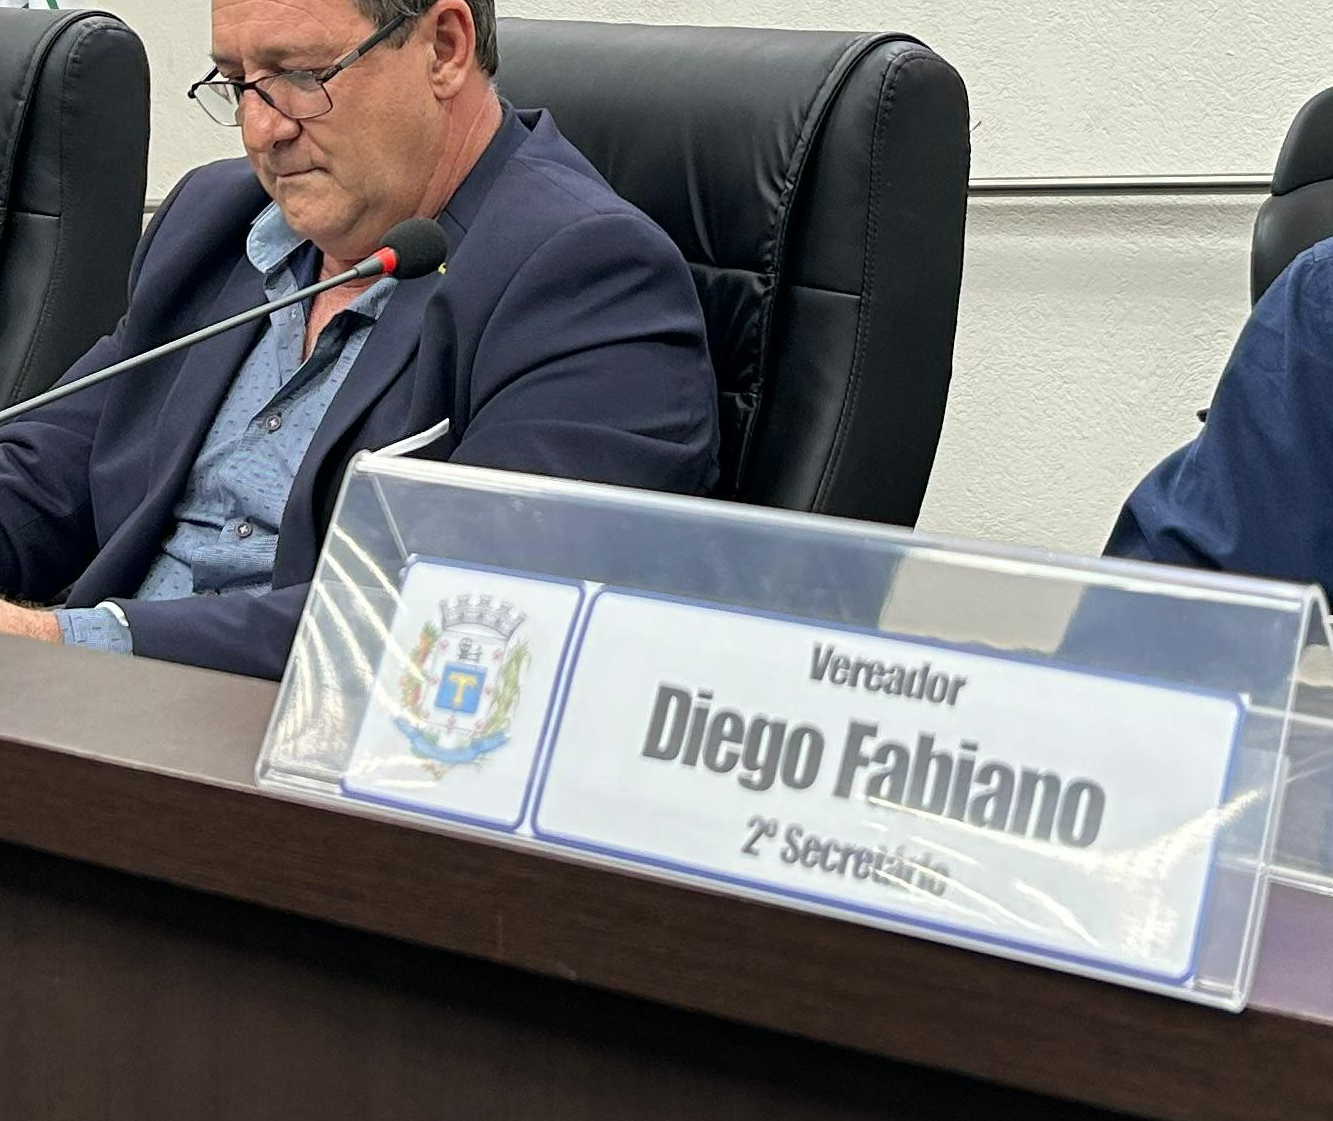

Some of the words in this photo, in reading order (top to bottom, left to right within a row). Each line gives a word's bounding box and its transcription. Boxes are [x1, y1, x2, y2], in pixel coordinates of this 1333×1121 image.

[808, 641, 968, 707] Vereador
[641, 680, 826, 792] Diego
[832, 718, 1107, 850] Fabiano
